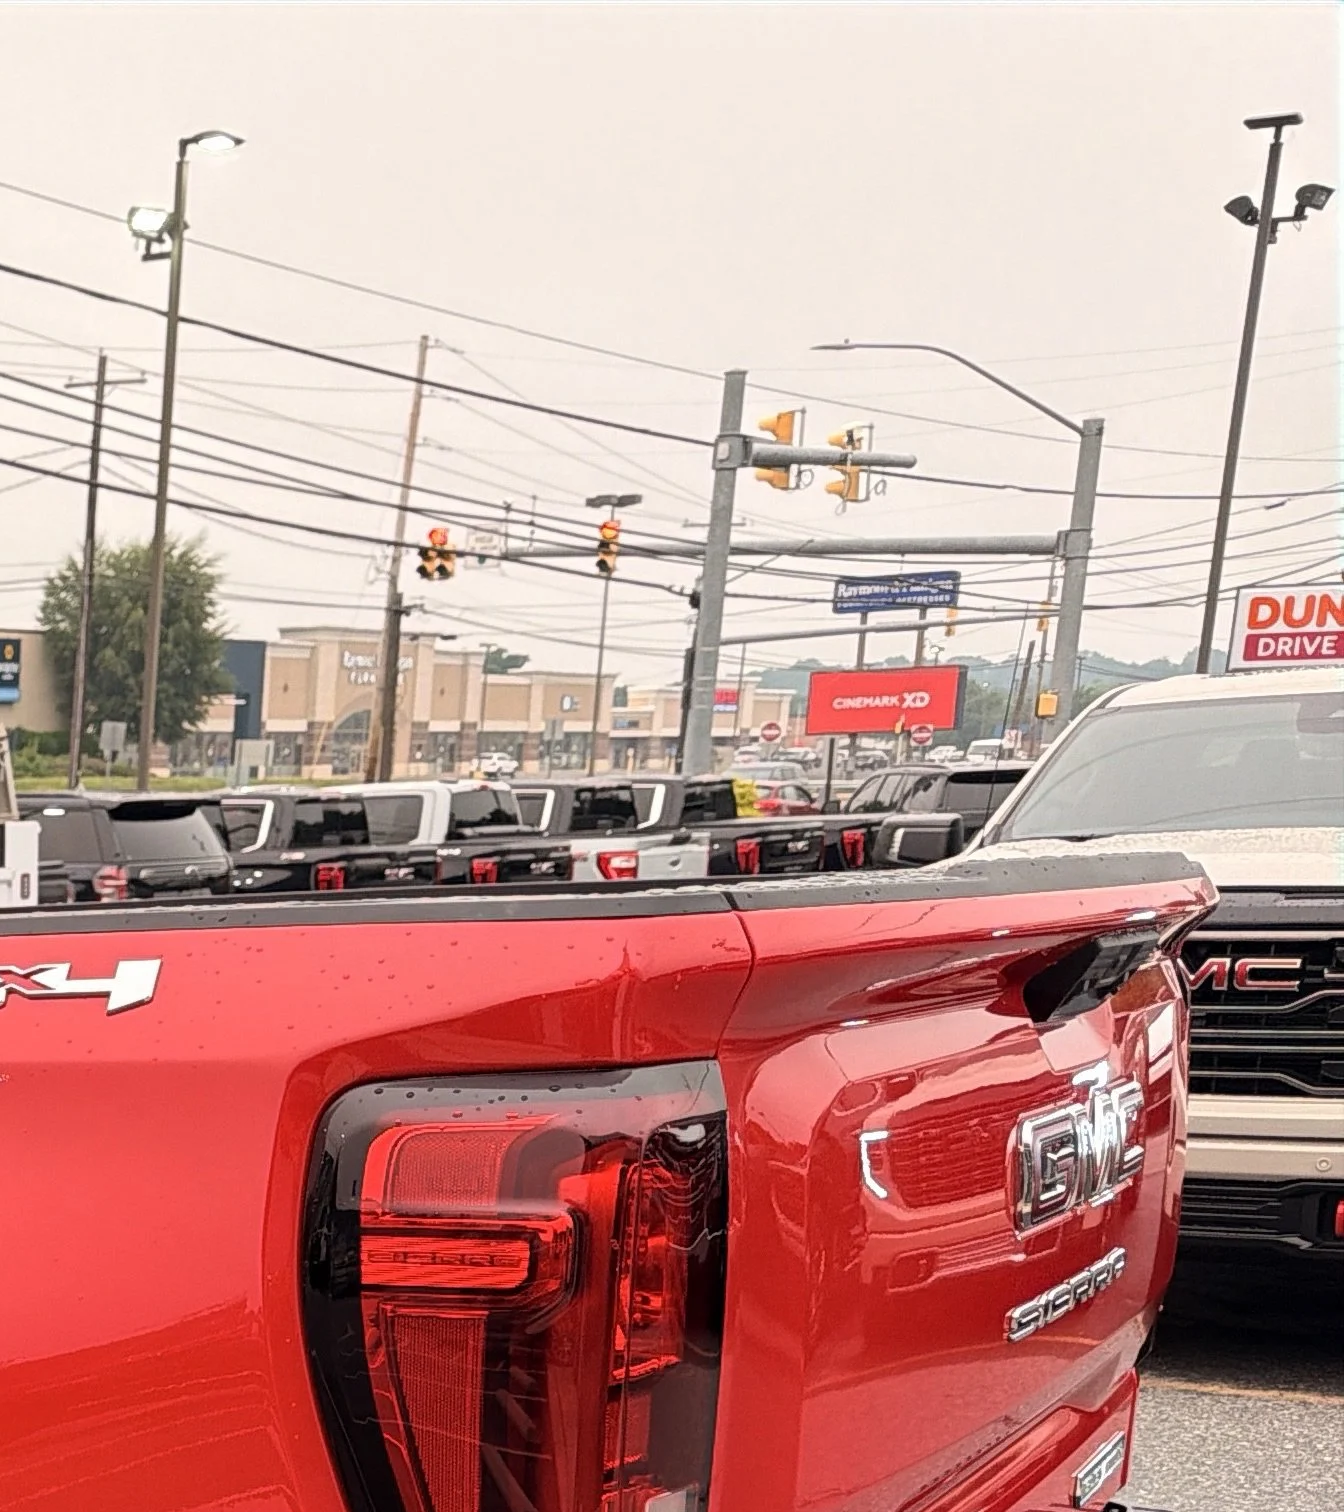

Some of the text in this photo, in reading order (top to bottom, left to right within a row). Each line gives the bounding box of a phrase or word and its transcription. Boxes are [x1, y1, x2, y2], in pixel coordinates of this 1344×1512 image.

[1257, 635, 1338, 657] DRIVE
[832, 691, 930, 709] CINEMARK XD
[1176, 956, 1302, 992] MC
[1016, 1078, 1145, 1231] GMC
